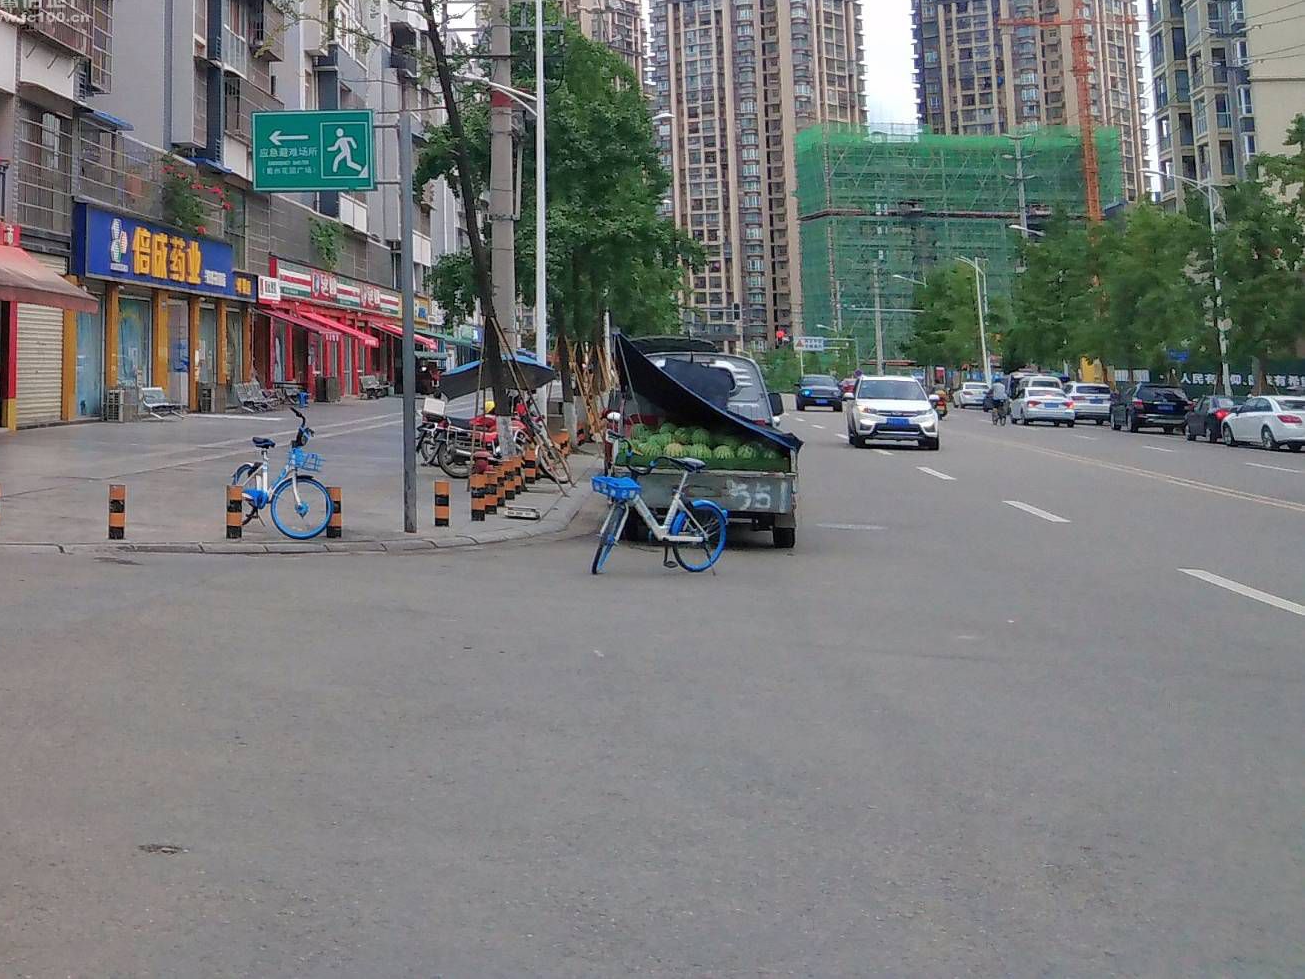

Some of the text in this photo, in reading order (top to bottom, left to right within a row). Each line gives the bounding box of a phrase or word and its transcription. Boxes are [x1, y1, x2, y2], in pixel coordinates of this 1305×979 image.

[259, 146, 319, 158] 应急避难场所
